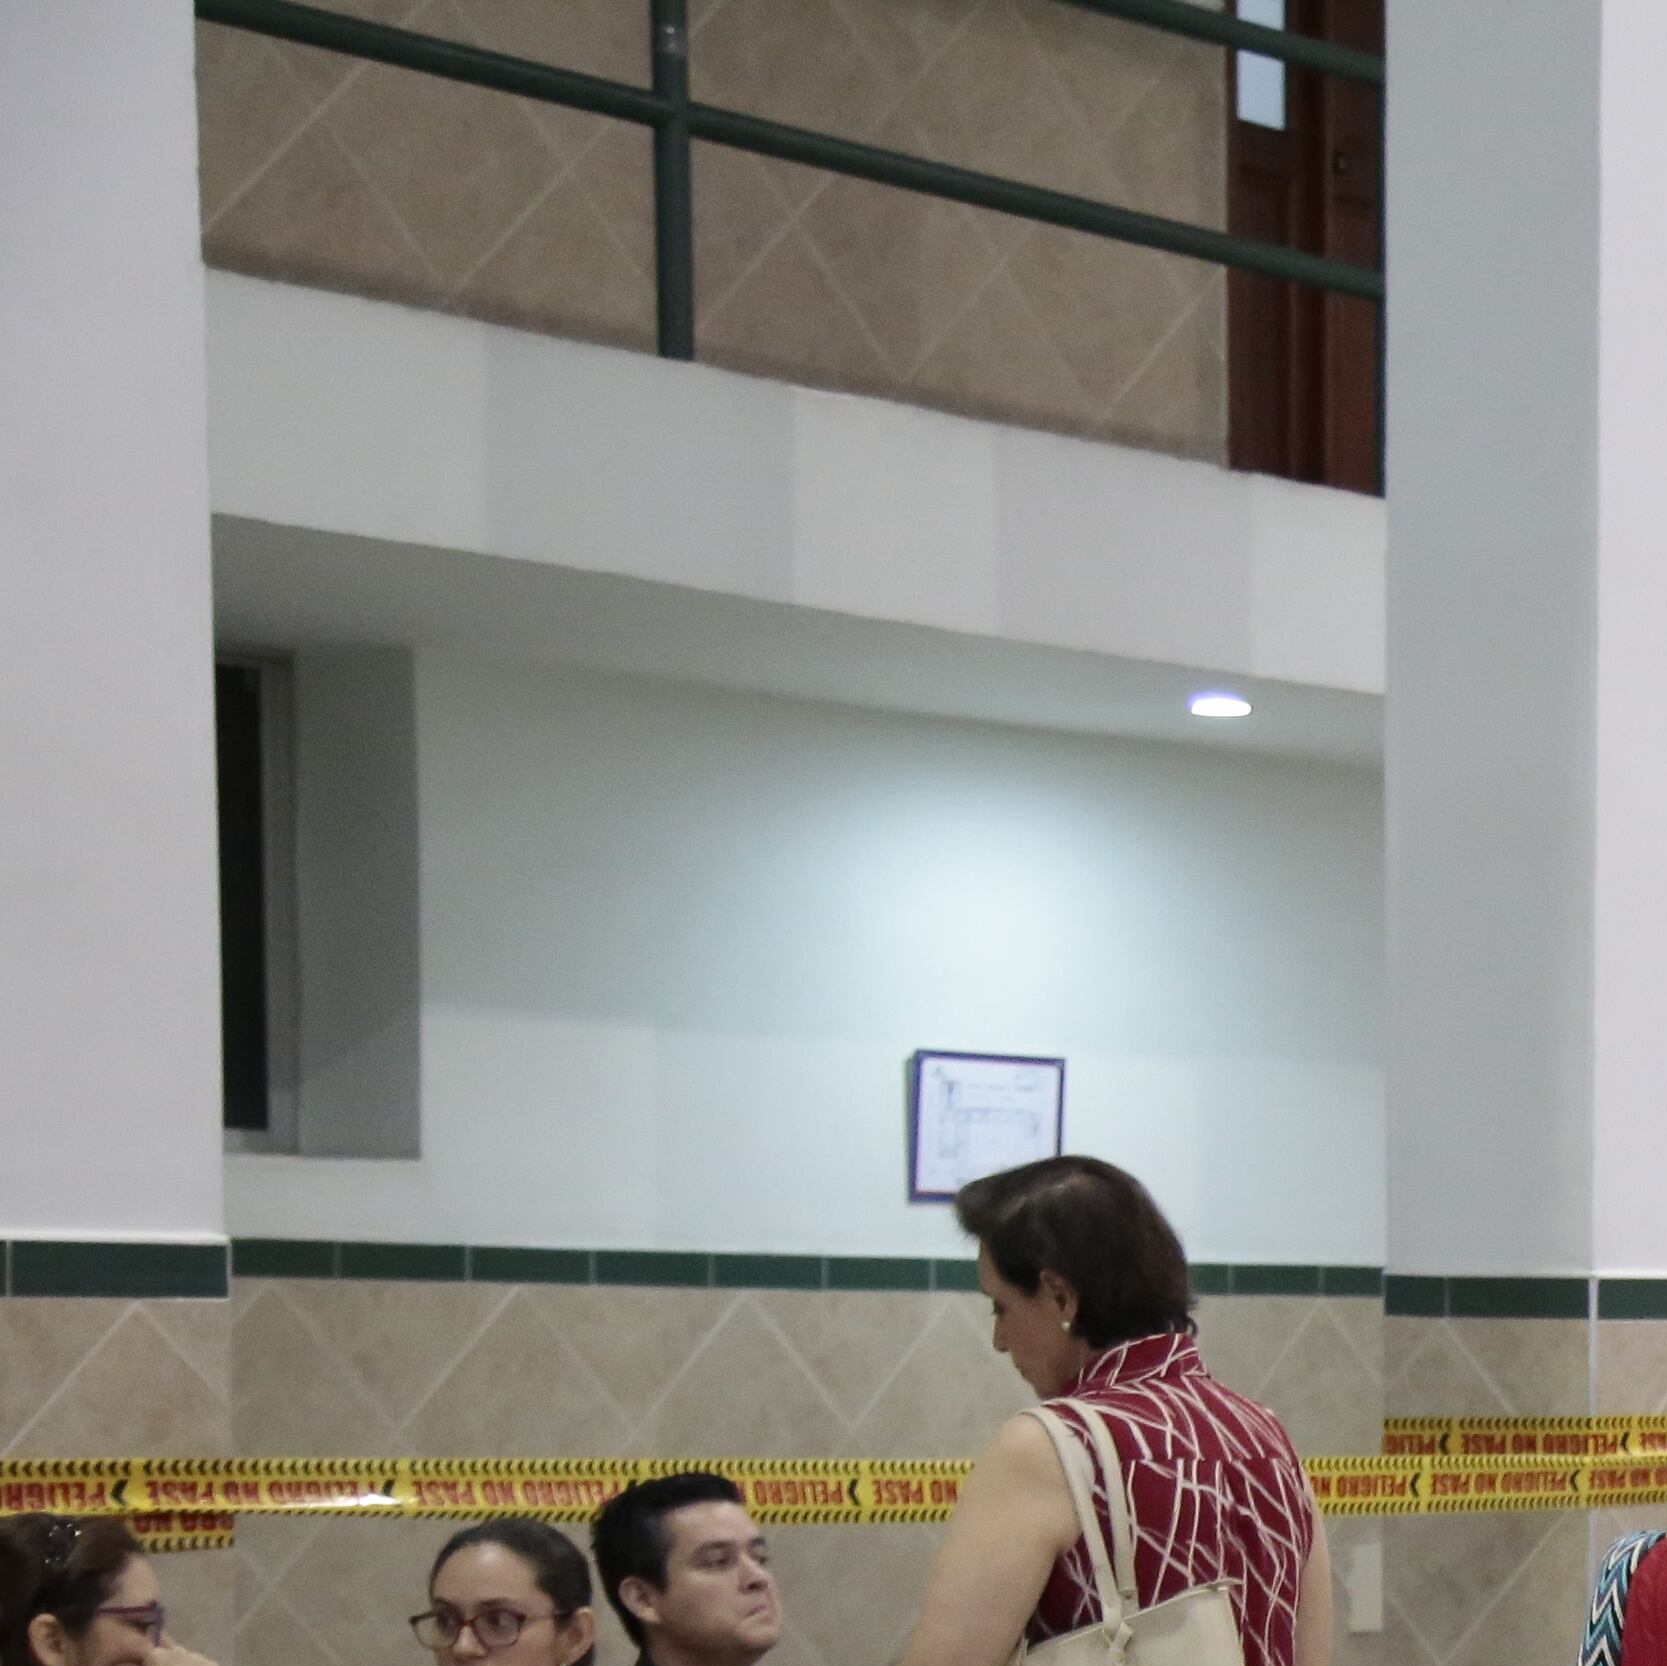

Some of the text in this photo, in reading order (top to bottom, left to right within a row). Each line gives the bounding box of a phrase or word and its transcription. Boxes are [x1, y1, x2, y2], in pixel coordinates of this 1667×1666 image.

[146, 1479, 214, 1506] PASE
[223, 1480, 260, 1505] NO
[413, 1480, 477, 1506] PASE
[482, 1480, 515, 1506] NO
[754, 1480, 844, 1505] PELIGRO
[872, 1479, 923, 1506] PASE
[1337, 1473, 1407, 1497] PELIGRO
[1431, 1471, 1471, 1495] PASE
[1475, 1472, 1497, 1494] NO
[1502, 1470, 1567, 1493] PELIGRO
[0, 1481, 105, 1511] PELIGR
